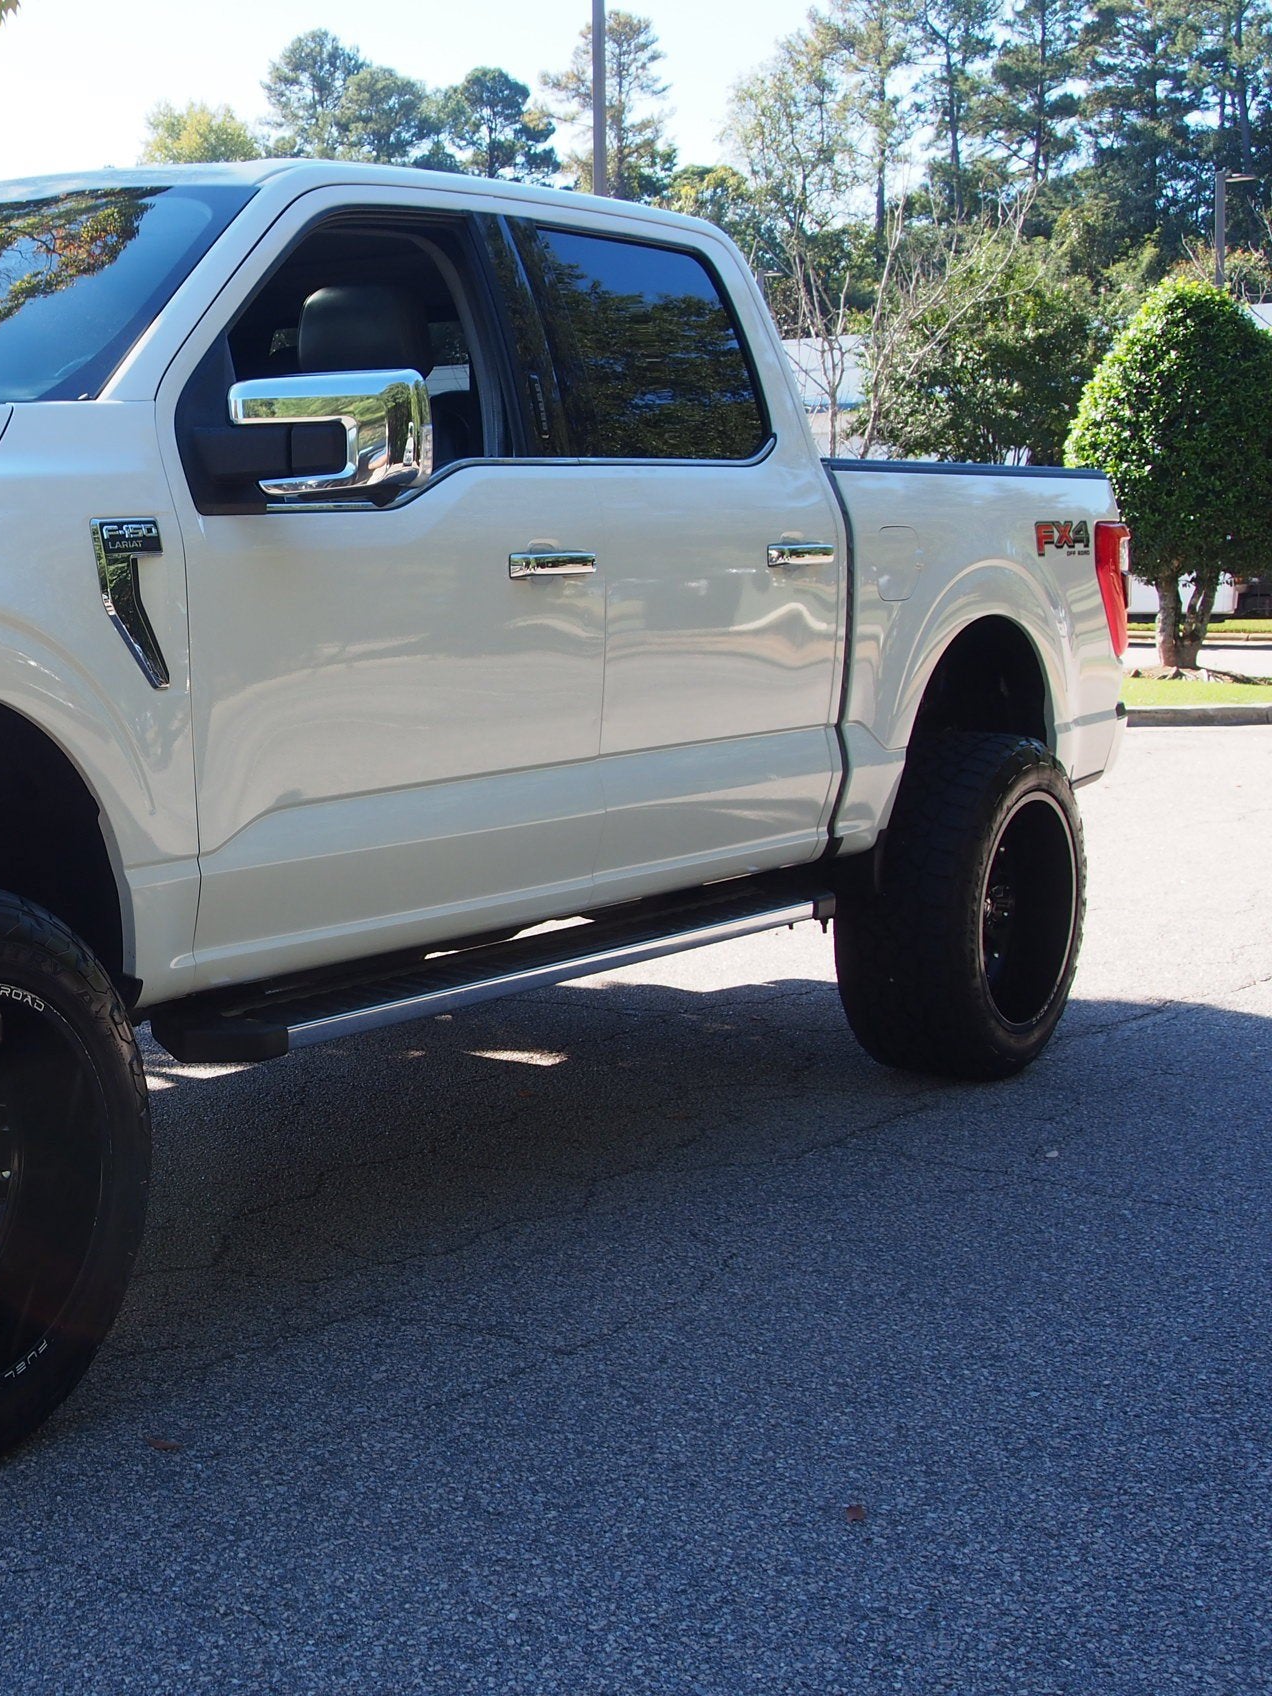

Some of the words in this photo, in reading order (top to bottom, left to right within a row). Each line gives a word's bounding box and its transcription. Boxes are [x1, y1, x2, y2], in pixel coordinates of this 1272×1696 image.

[102, 524, 158, 540] F-150
[109, 540, 143, 549] LARIAT
[1035, 521, 1090, 557] FX4
[4, 1339, 48, 1378] FUEL
